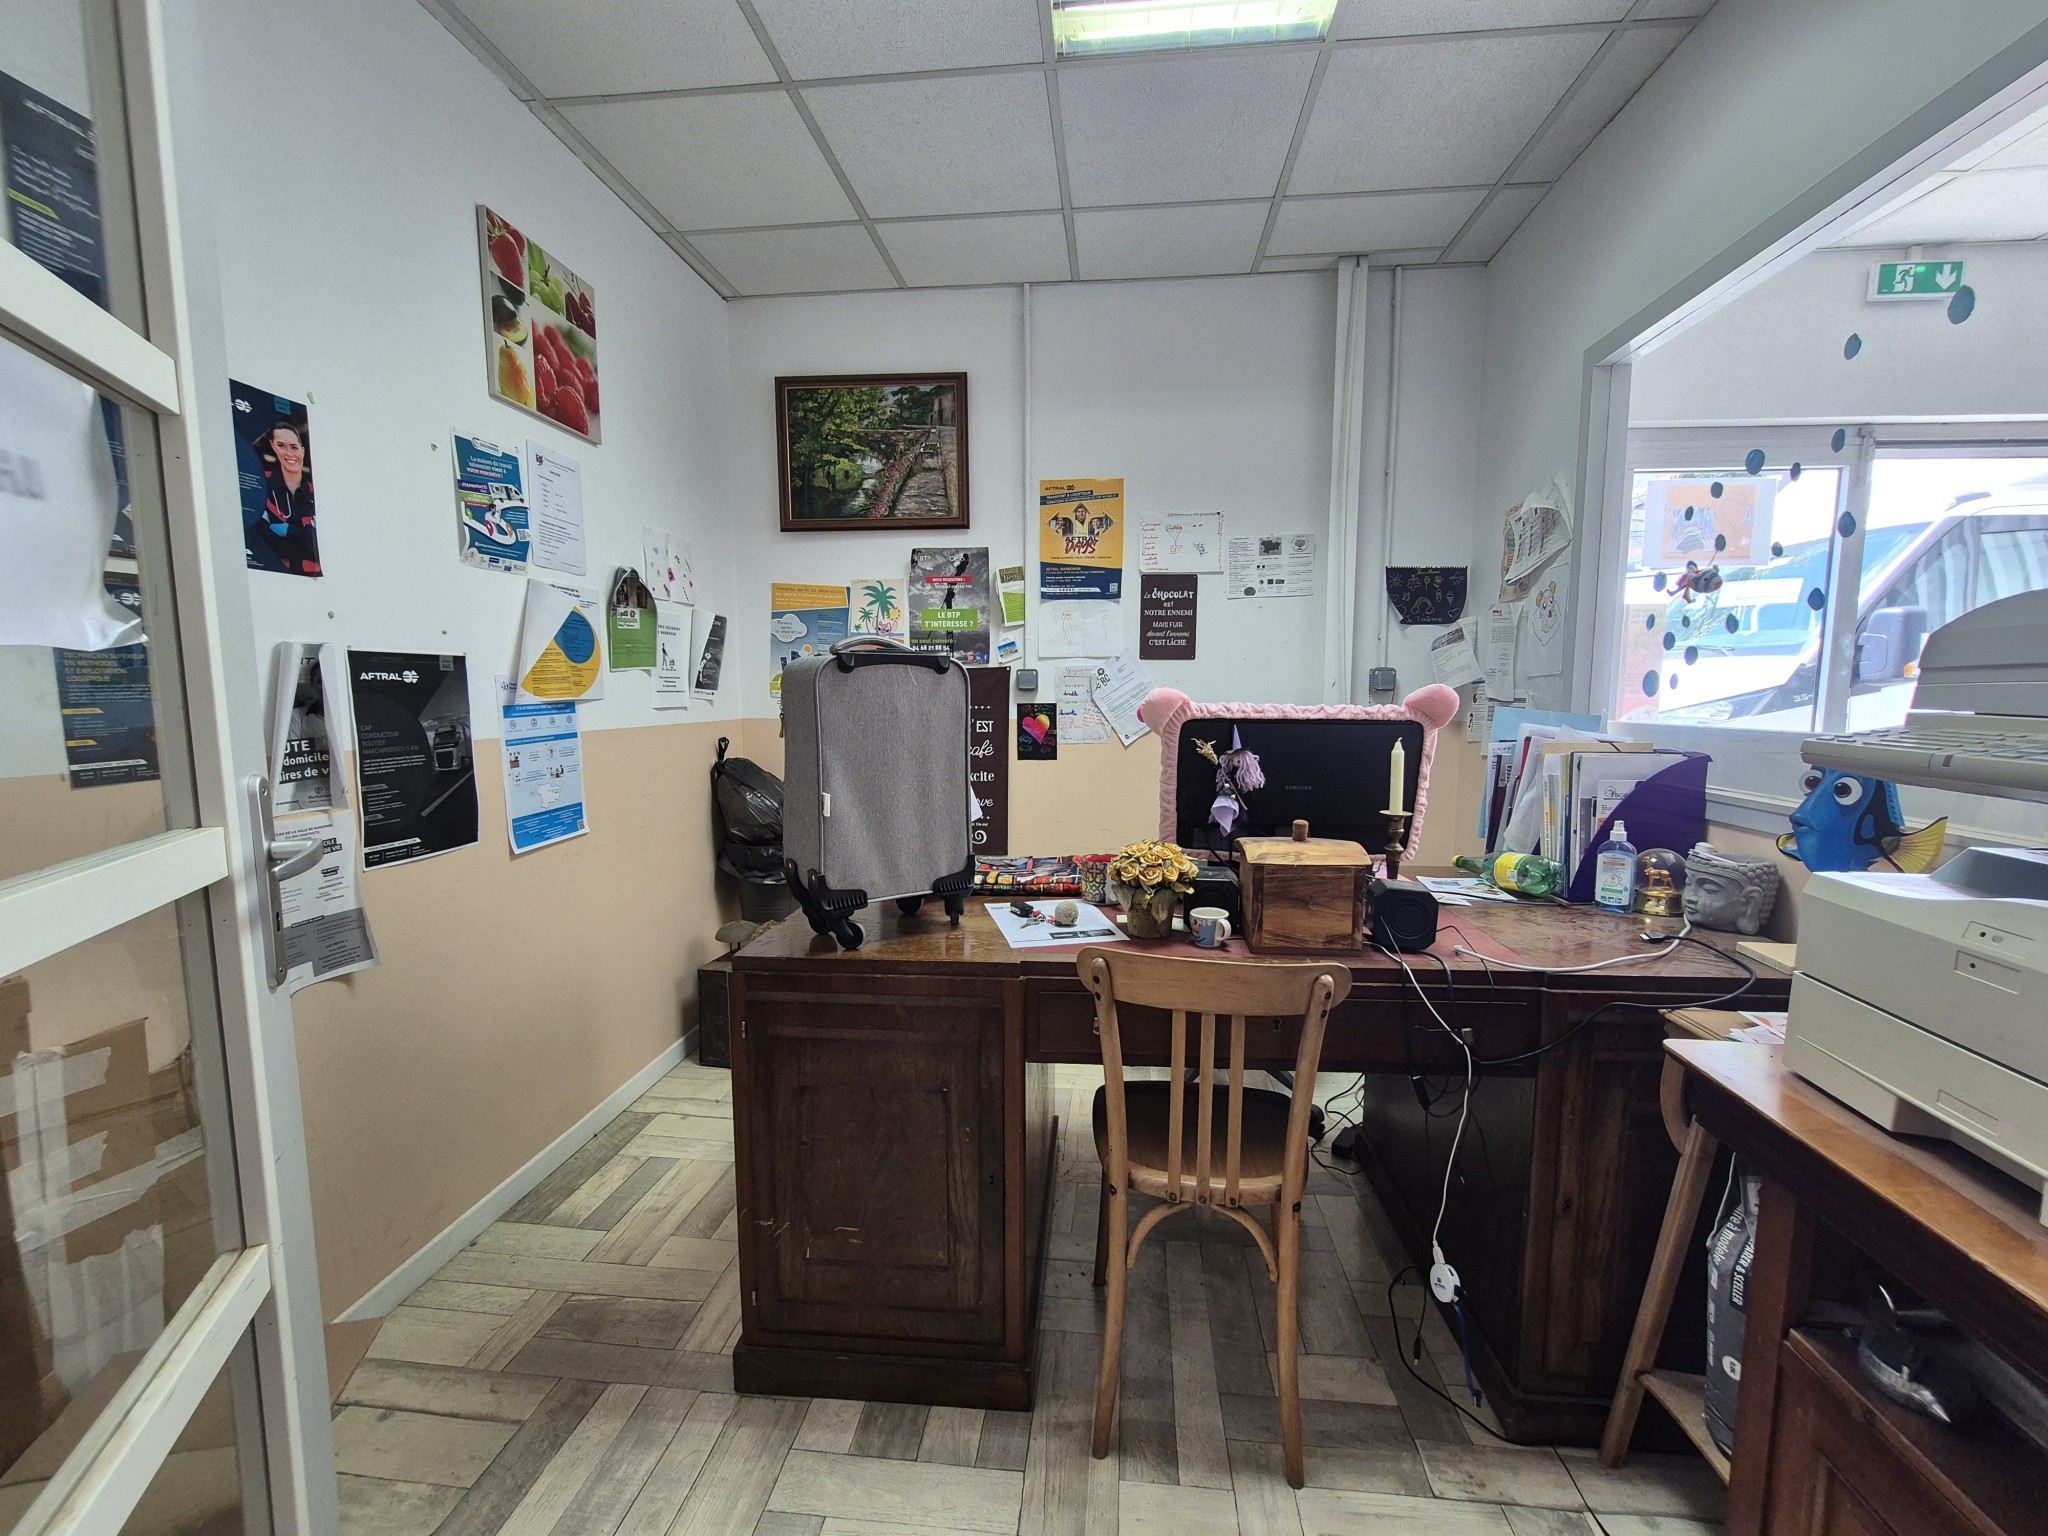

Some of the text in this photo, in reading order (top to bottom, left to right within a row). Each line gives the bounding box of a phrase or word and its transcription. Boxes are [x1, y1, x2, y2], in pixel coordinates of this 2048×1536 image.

[1064, 540, 1099, 555] DAYS
[1152, 588, 1195, 601] CHOCOLAT
[1167, 638, 1187, 646] LÂCHE
[360, 672, 403, 681] AFTRAL
[284, 753, 330, 766] domicile
[280, 770, 302, 782] ires
[304, 767, 319, 777] de
[1713, 1229, 1735, 1266] modeler
[1736, 1266, 1746, 1274] &
[1731, 1272, 1745, 1306] SCELLER
